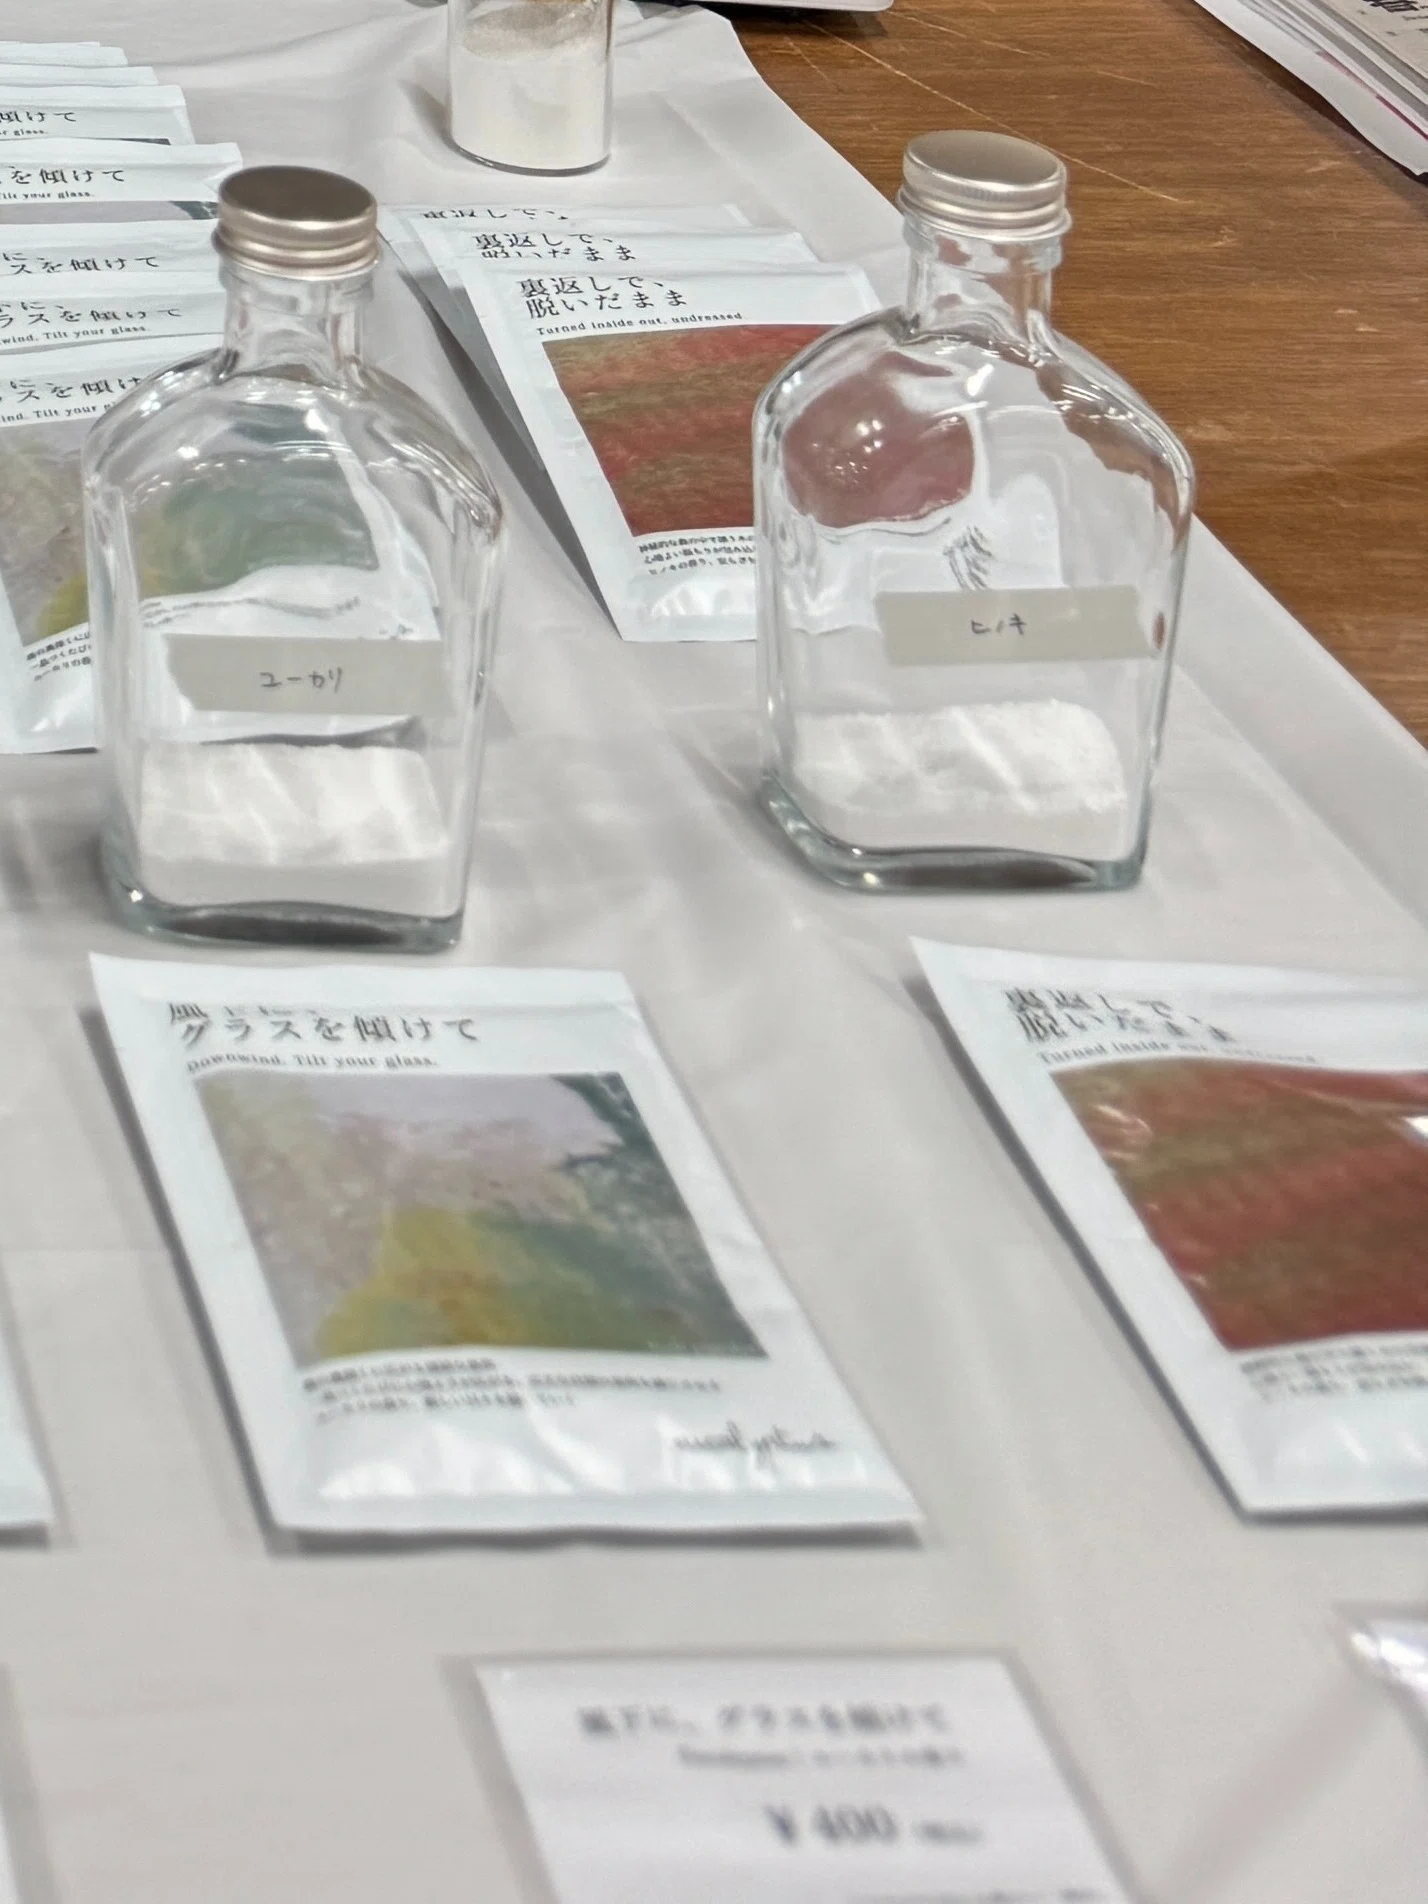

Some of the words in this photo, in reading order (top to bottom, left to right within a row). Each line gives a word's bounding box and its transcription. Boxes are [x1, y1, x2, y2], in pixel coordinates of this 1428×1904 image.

[516, 276, 665, 298] 裏返して、
[525, 290, 688, 320] 脱いだまま
[535, 322, 586, 336] Turned
[969, 612, 1028, 637] ヒノキ
[260, 666, 344, 694] ユーカリ
[180, 1014, 480, 1049] グラスを傾けて
